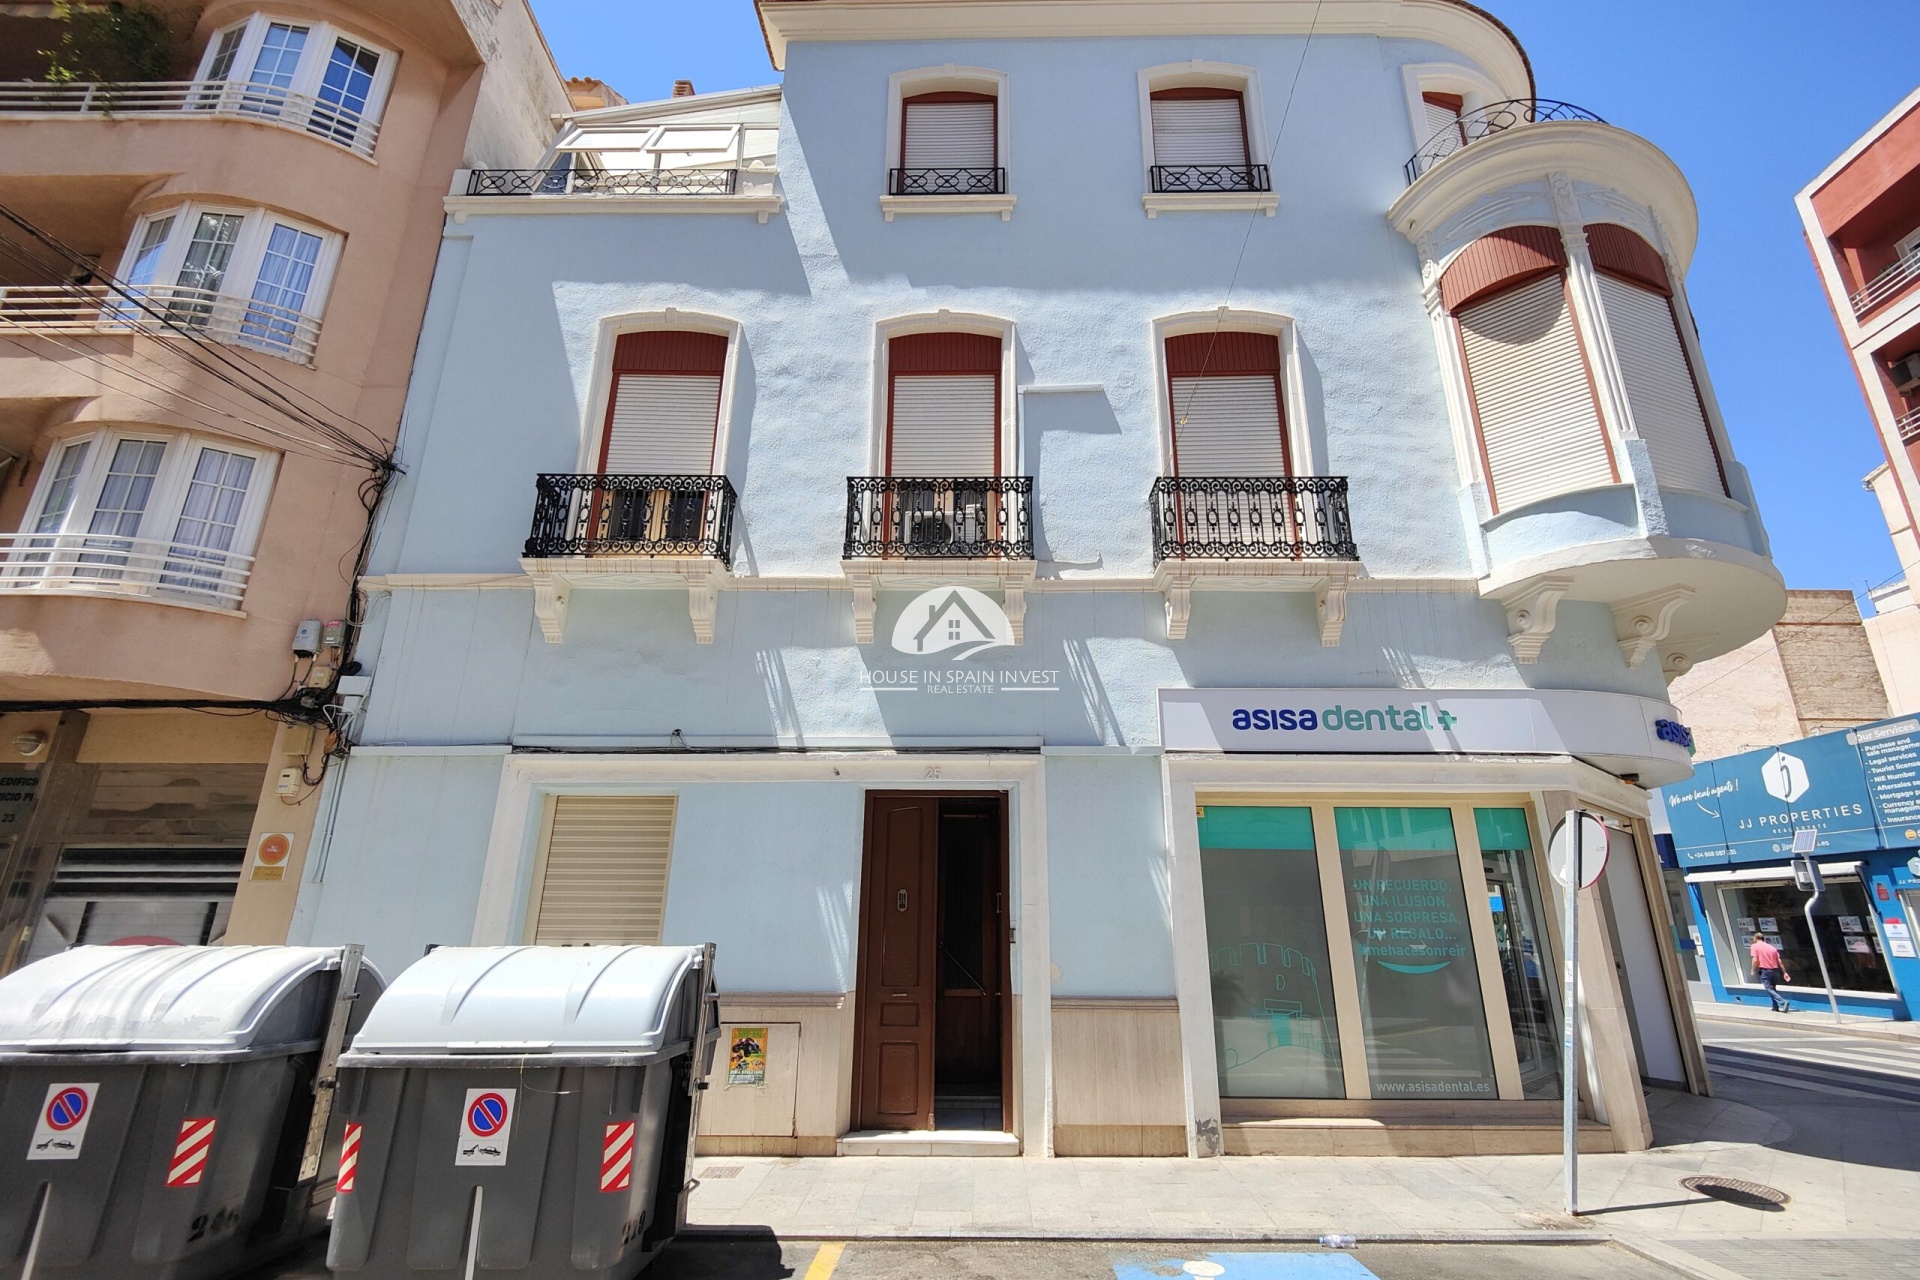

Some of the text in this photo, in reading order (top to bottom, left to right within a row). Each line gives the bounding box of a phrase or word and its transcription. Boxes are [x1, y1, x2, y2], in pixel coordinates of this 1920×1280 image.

[1232, 704, 1434, 731] asisa dental
[1873, 723, 1916, 738] Services
[1864, 737, 1911, 752] Purchase and
[1881, 742, 1920, 754] manageme
[1868, 751, 1917, 766] Legal services
[925, 766, 941, 779] 25
[1871, 764, 1896, 775] Tourist
[1887, 771, 1916, 780] Number
[1877, 781, 1912, 791] Aftersales
[1669, 794, 1681, 808] We
[1681, 793, 1693, 803] are
[1693, 787, 1710, 800] local
[1710, 780, 1733, 797] agents
[1879, 790, 1914, 800] Mortgage
[1882, 799, 1915, 809] Currency
[1, 813, 16, 823] 23
[1739, 803, 1863, 829] JJ PROPERTIES
[1353, 879, 1452, 892] UN RECUERDO,
[1359, 891, 1450, 909] UNA ILUSIÓN,
[1354, 911, 1461, 926] UNA SORPRESA,
[1367, 928, 1387, 940] UN
[1358, 944, 1466, 957] #mehacesonreir
[1376, 1081, 1491, 1093] www.asisadental.es
